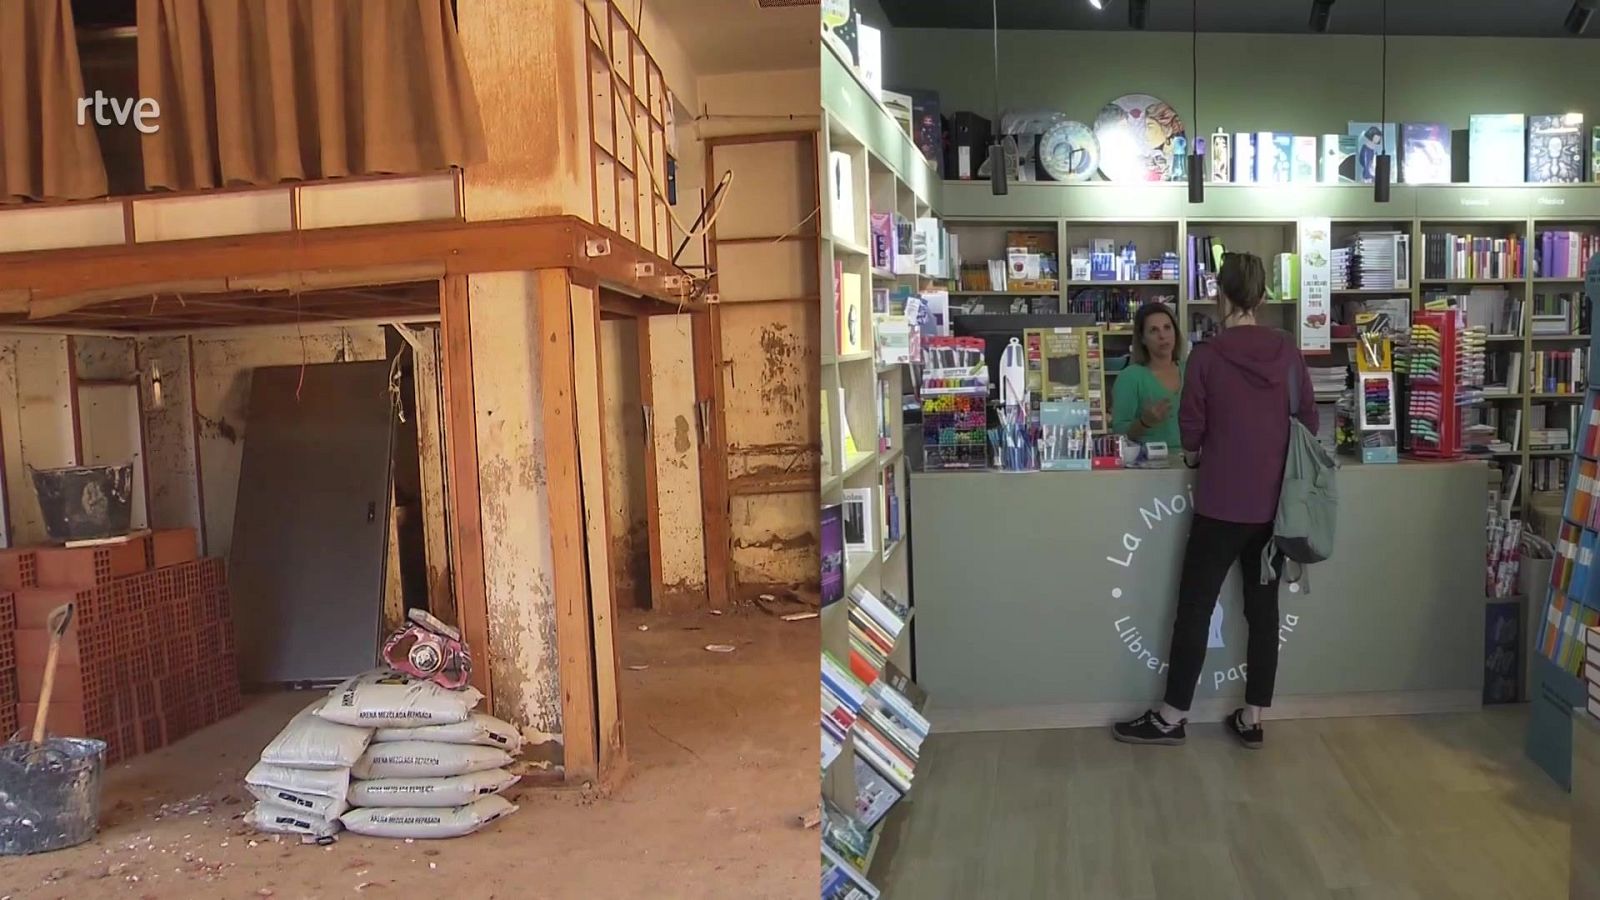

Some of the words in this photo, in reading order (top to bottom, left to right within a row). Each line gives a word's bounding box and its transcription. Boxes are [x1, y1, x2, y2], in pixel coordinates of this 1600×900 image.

[1106, 532, 1142, 567] La
[1139, 484, 1195, 530] Moi
[1114, 616, 1170, 675] Llibrer
[359, 710, 378, 719] ARENA
[378, 710, 406, 719] MEZCLADA
